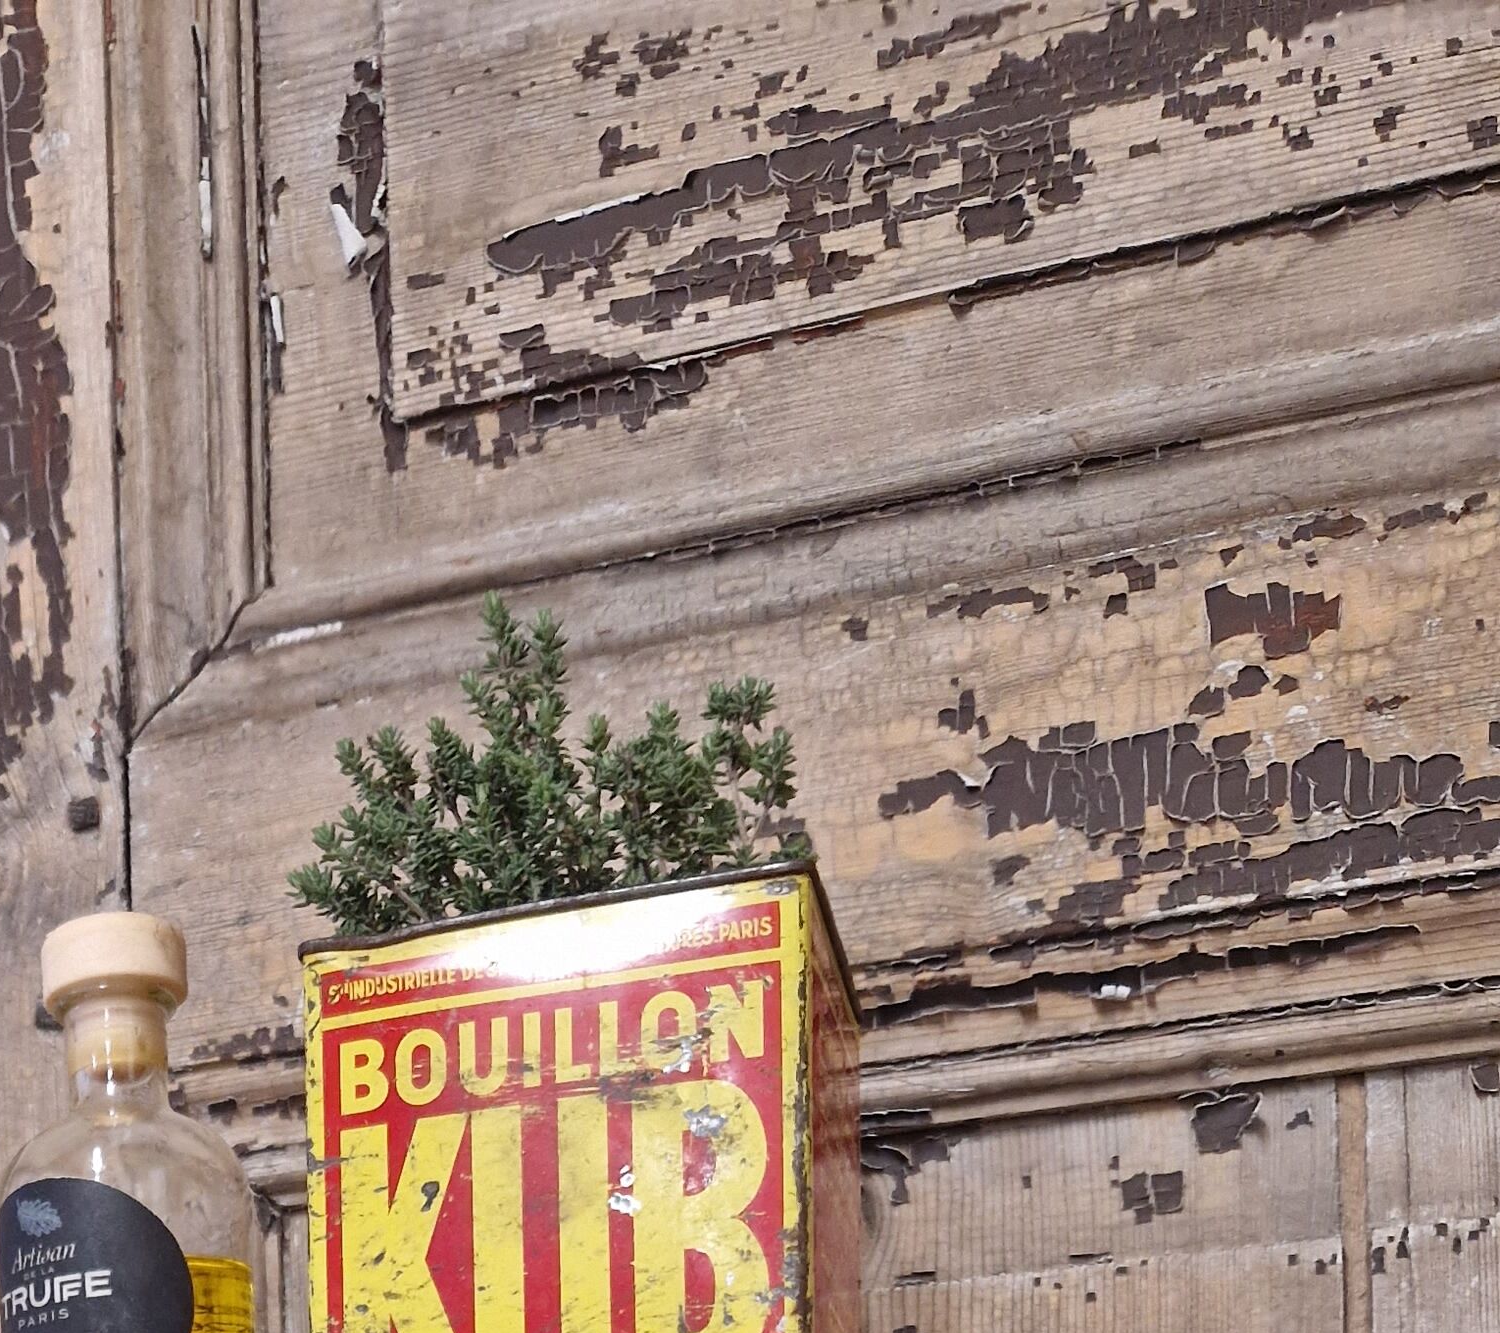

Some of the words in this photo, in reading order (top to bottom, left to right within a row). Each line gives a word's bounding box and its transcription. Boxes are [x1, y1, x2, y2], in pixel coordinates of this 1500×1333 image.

[348, 967, 457, 1001] INDUSTRIELLE
[718, 915, 773, 942] PARIS
[339, 979, 767, 1117] BOUILLON
[11, 1242, 76, 1275] Artisan
[18, 1308, 70, 1330] PARIS
